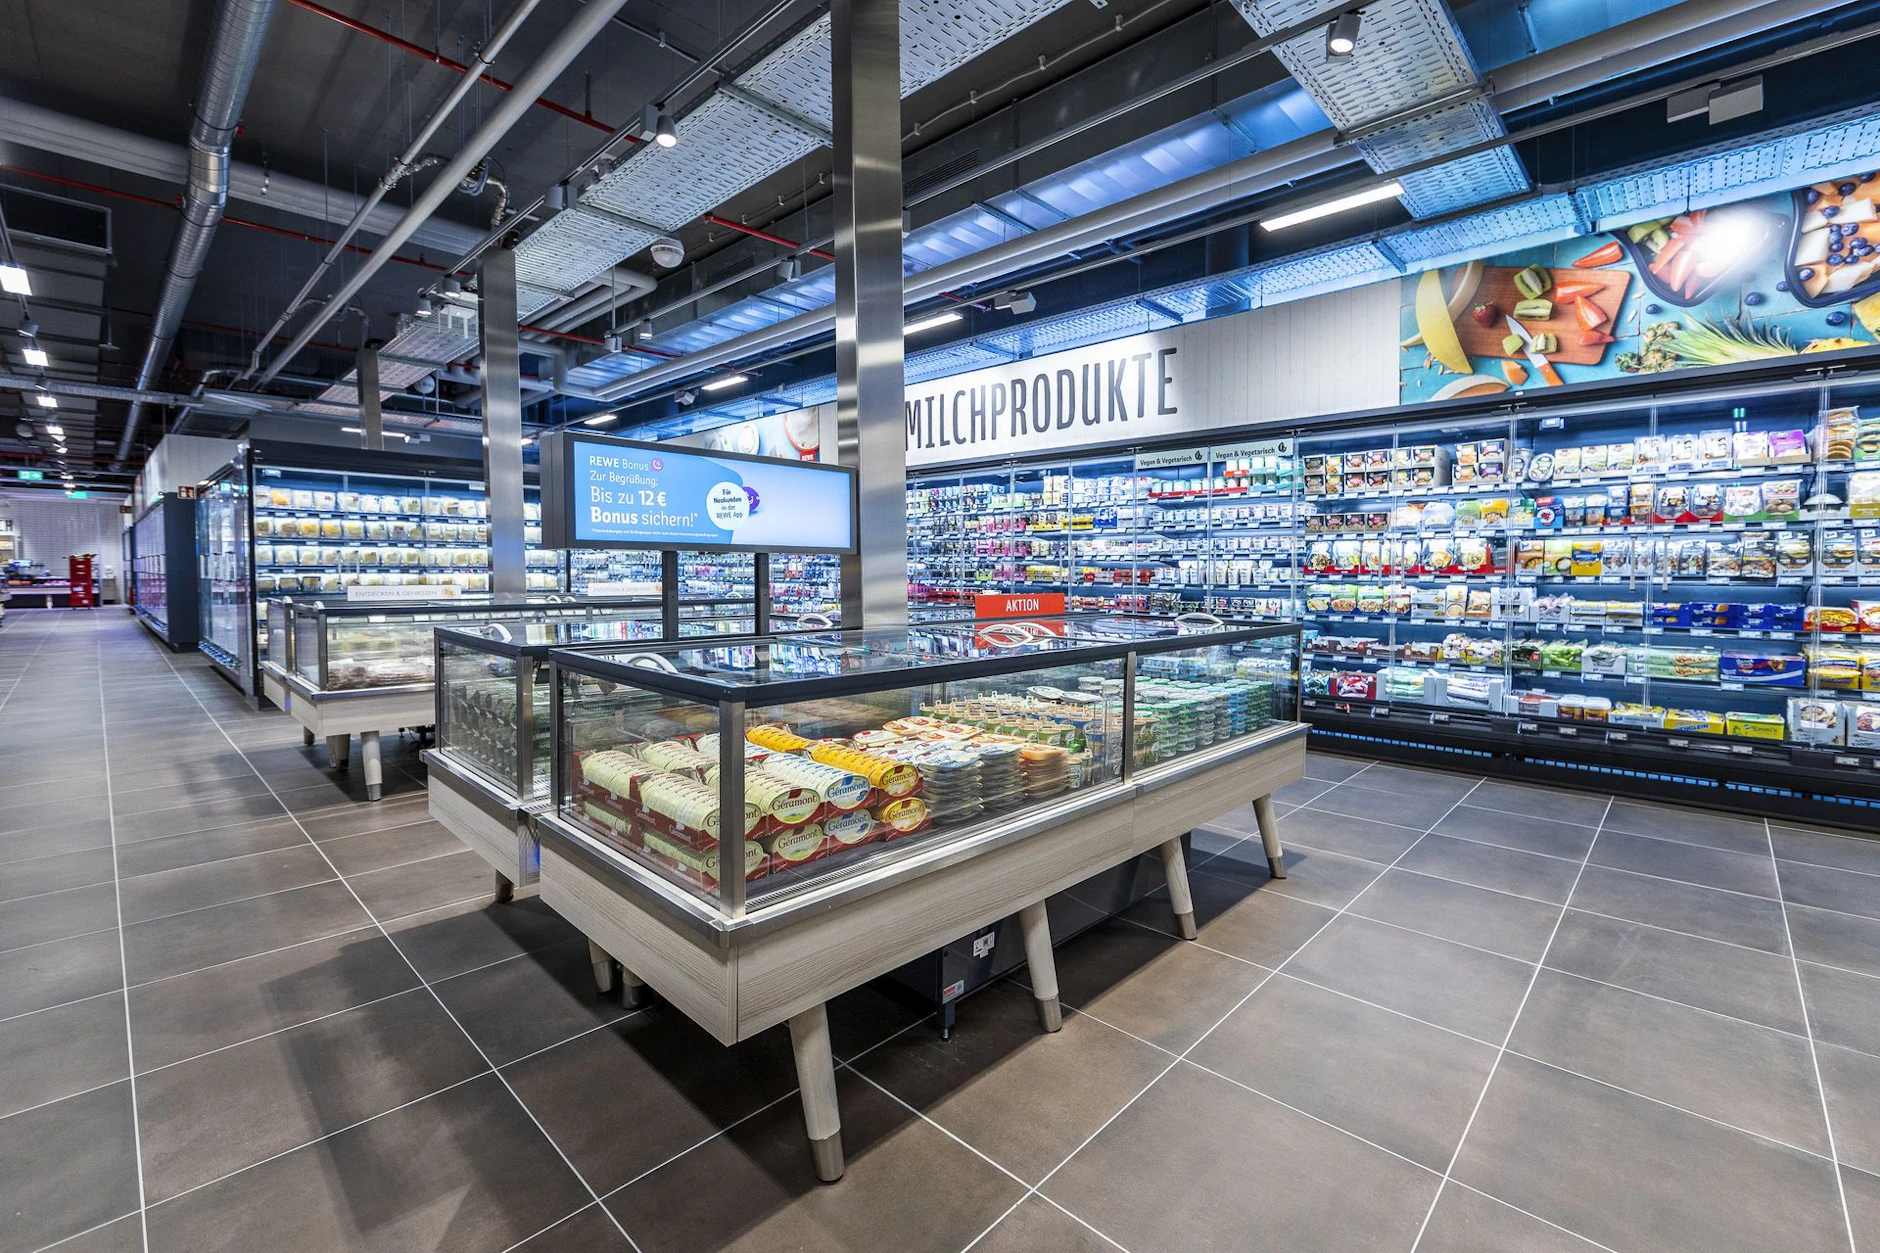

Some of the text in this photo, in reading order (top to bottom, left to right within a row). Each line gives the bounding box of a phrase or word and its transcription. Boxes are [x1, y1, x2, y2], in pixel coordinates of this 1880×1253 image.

[905, 347, 1178, 451] MILCHPRODUKTE
[1140, 458, 1156, 466] Vegan
[1161, 455, 1192, 465] Vegetarisch
[1216, 451, 1233, 460] Vegan
[1240, 447, 1275, 458] Vegetarisch
[589, 455, 649, 471] REWE Bonus
[590, 470, 658, 488] Zur Begrüßung:
[590, 485, 667, 507] Bis zu 12 €
[590, 506, 638, 524] Bonus
[733, 512, 743, 520] App
[1005, 598, 1039, 612] AKTION
[882, 769, 917, 786] Géramont
[827, 779, 867, 798] Géramont
[772, 794, 817, 811] Géramont
[888, 803, 923, 820] Géramont
[828, 812, 867, 831] Géramont
[778, 828, 822, 849] Géramont
